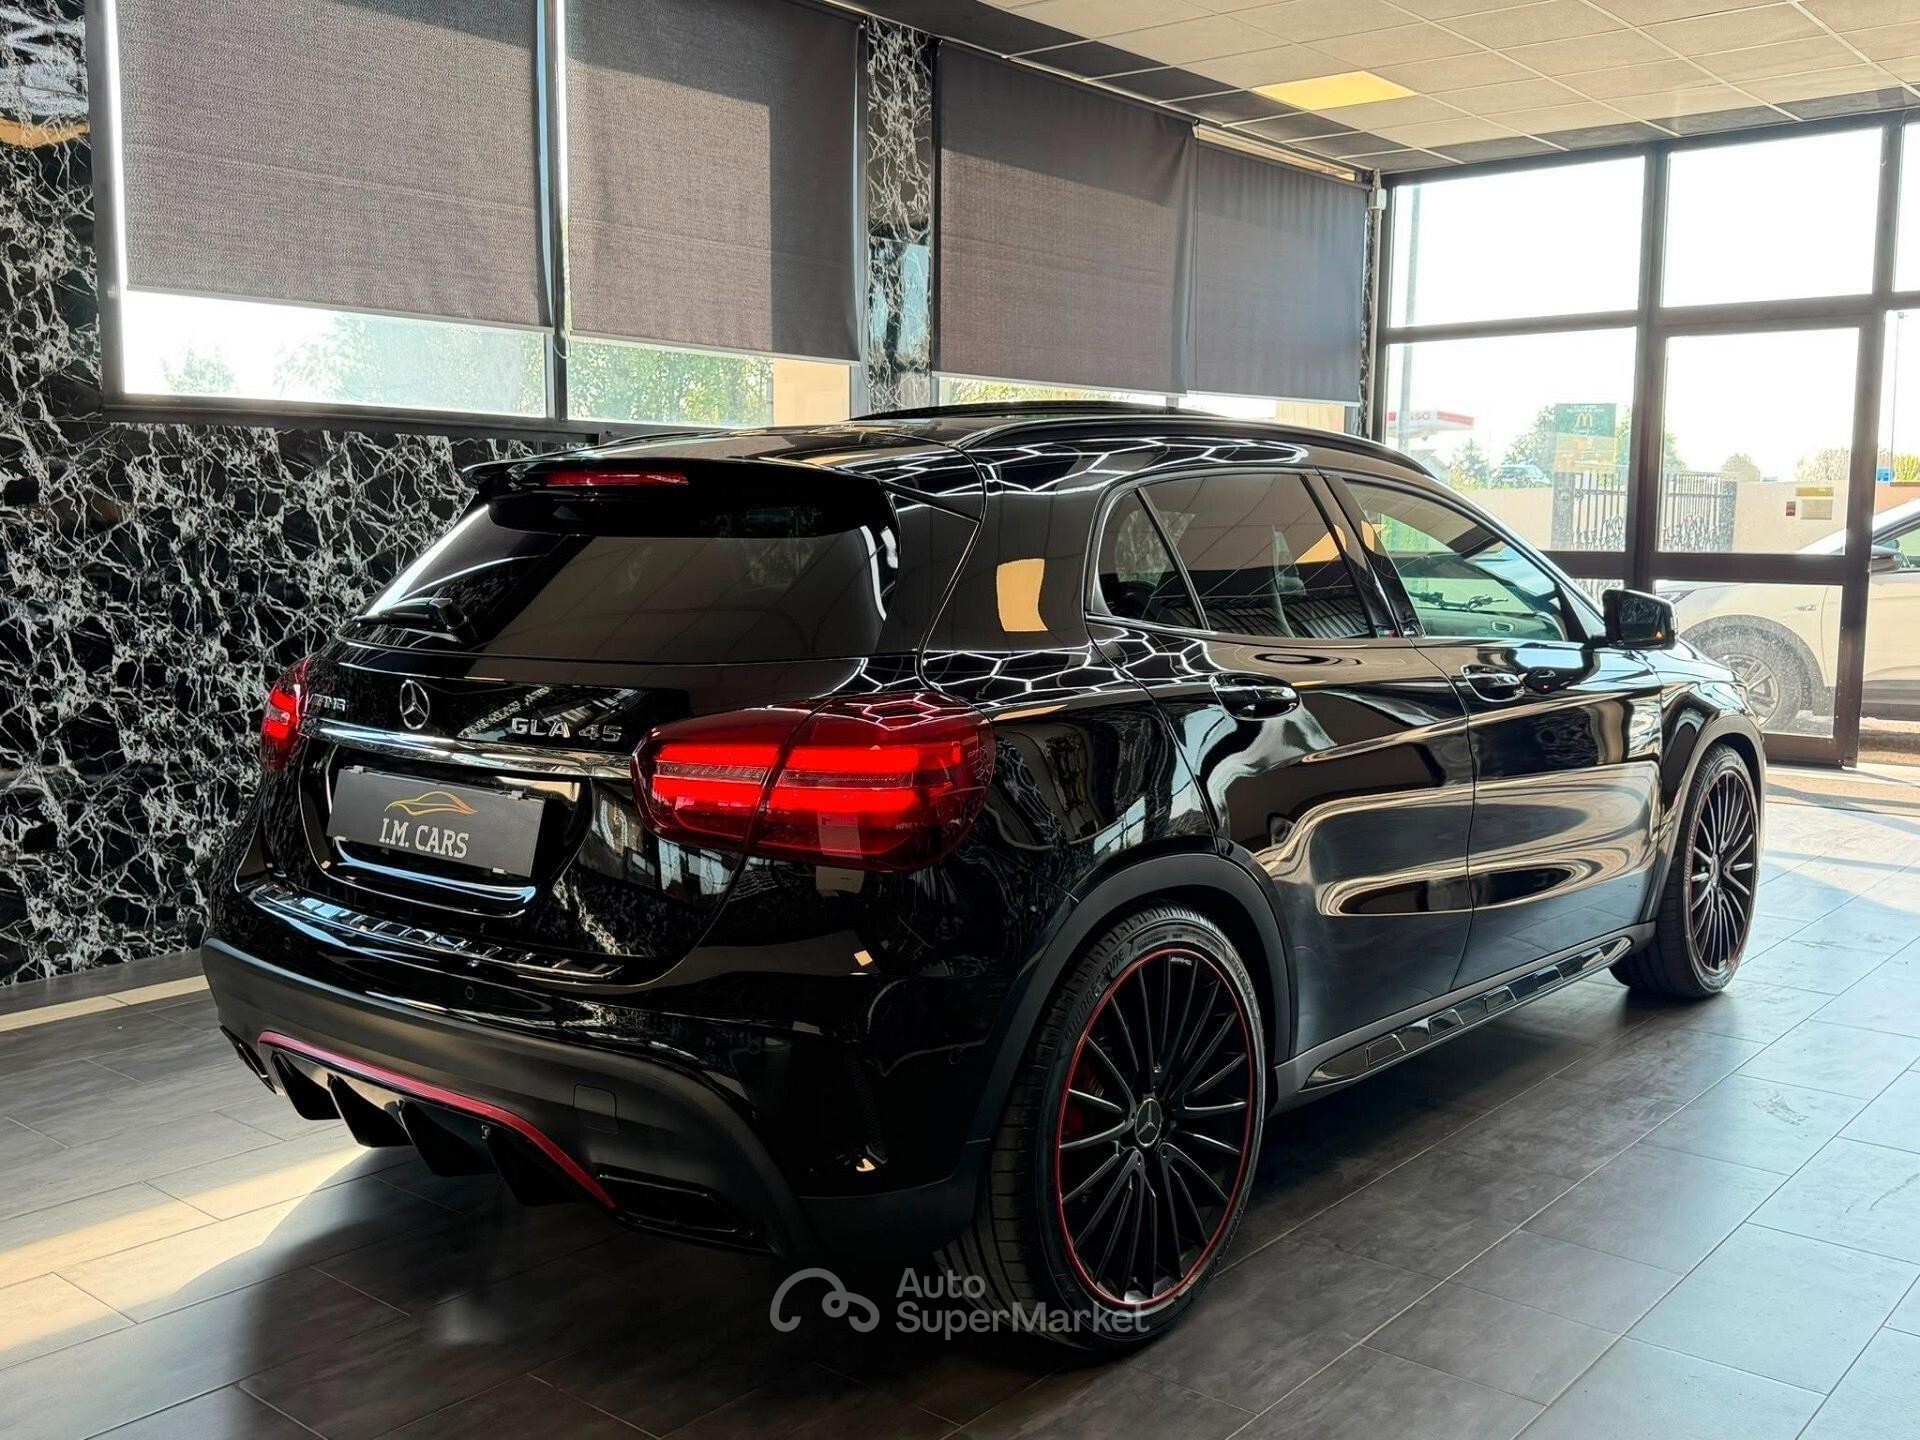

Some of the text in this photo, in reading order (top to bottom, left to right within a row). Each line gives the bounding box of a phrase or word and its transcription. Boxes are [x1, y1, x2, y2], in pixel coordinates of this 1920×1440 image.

[511, 717, 622, 742] GLA 45
[379, 818, 469, 858] I.M. CARS
